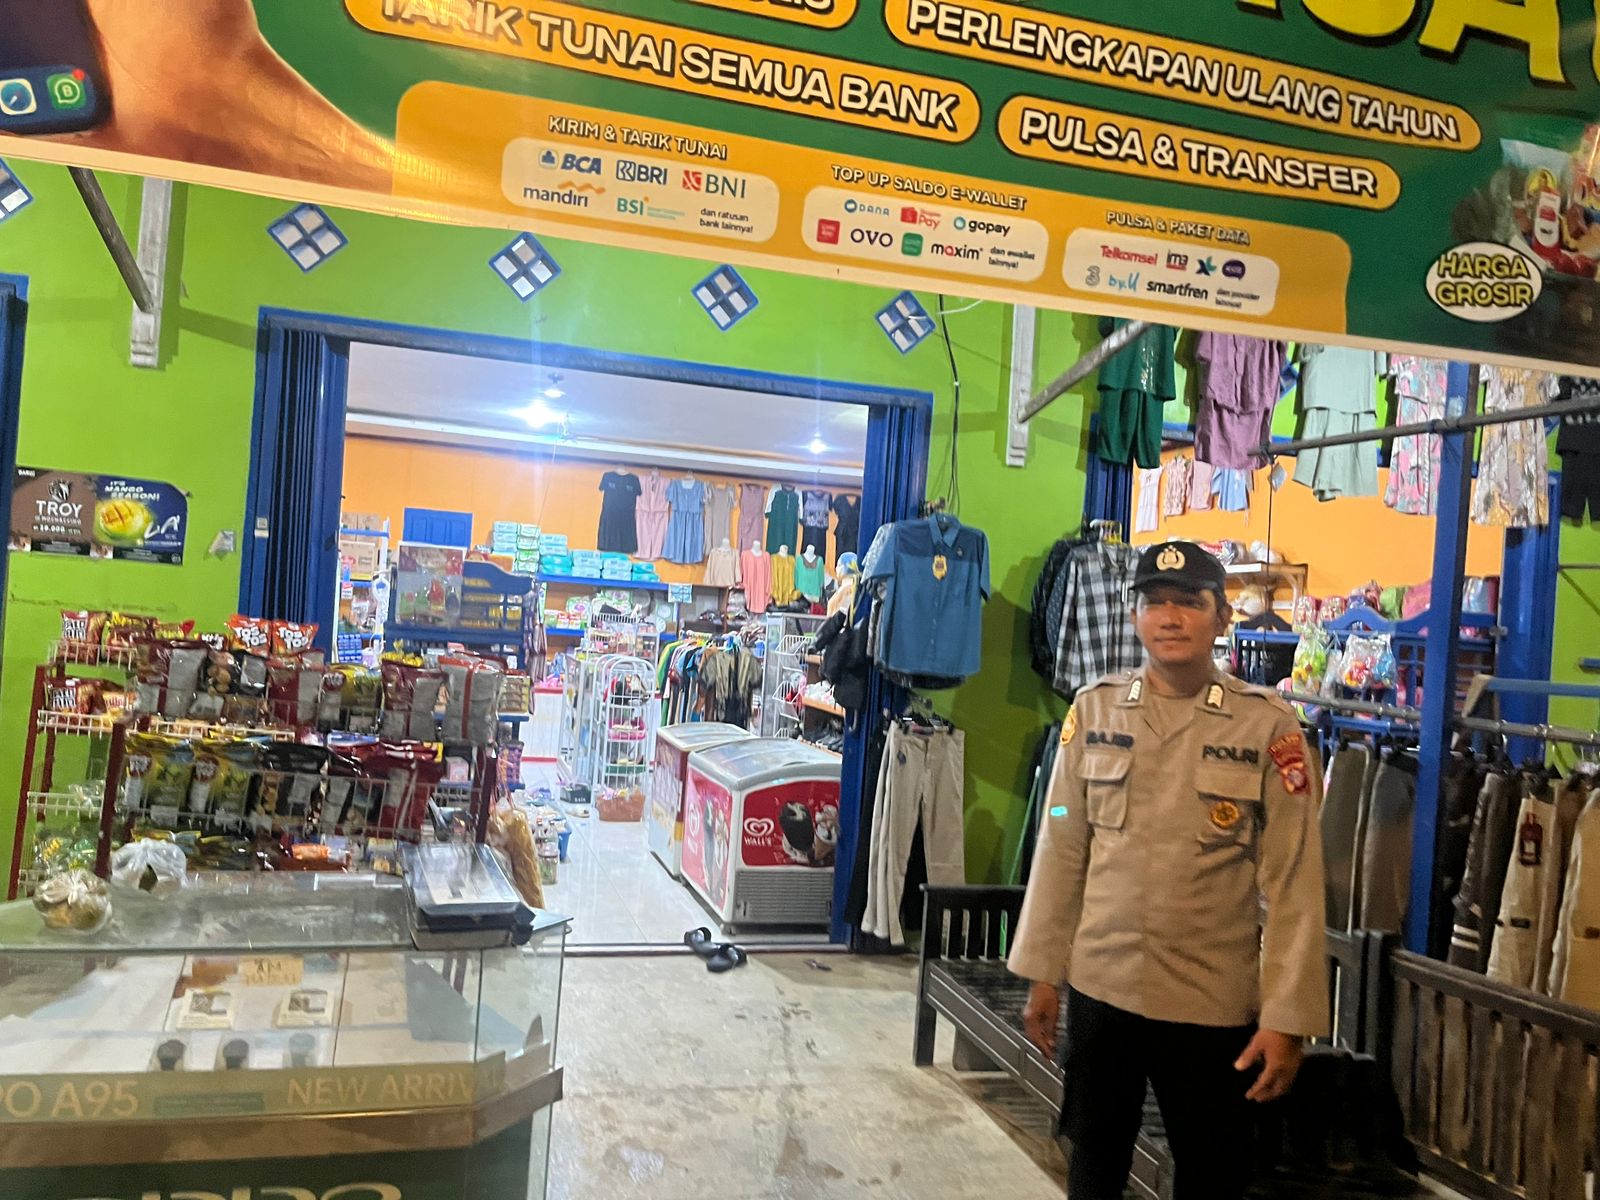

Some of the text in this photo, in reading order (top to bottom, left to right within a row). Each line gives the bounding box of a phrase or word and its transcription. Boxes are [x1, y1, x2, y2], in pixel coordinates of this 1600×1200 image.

[529, 12, 674, 75] TUNAI
[681, 44, 834, 108] SEMUA
[840, 75, 959, 130] BANK
[908, 0, 1220, 95] PERLENGKAPAN
[1224, 64, 1342, 122] ULANG
[1348, 94, 1459, 142] TAHUN
[548, 115, 728, 160] KIRIM & TARIK TUNAI
[1020, 109, 1378, 197] PULSA & TRANSFER
[561, 153, 747, 199] BCA BRI BNI
[831, 165, 864, 184] TOP
[868, 172, 890, 187] UP
[894, 177, 947, 198] SALDO
[950, 186, 1027, 212] E-WALLET
[523, 186, 588, 208] mandiri
[616, 197, 645, 216] BSI
[700, 207, 749, 222] dan ratusan
[859, 203, 891, 217] DANA
[699, 218, 720, 229] bank
[968, 219, 1011, 237] gopay
[1106, 210, 1251, 246] PULSA & PAKET DATA
[850, 228, 894, 248] OVO
[930, 243, 980, 261] maxim
[1100, 244, 1158, 266] Telkomsel
[1437, 252, 1531, 279] HARGA
[1146, 280, 1209, 301] smartfren
[1435, 281, 1534, 308] GROSIR
[36, 500, 82, 518] TROY
[0, 1079, 140, 1119] O A95
[287, 1075, 368, 1106] NEW
